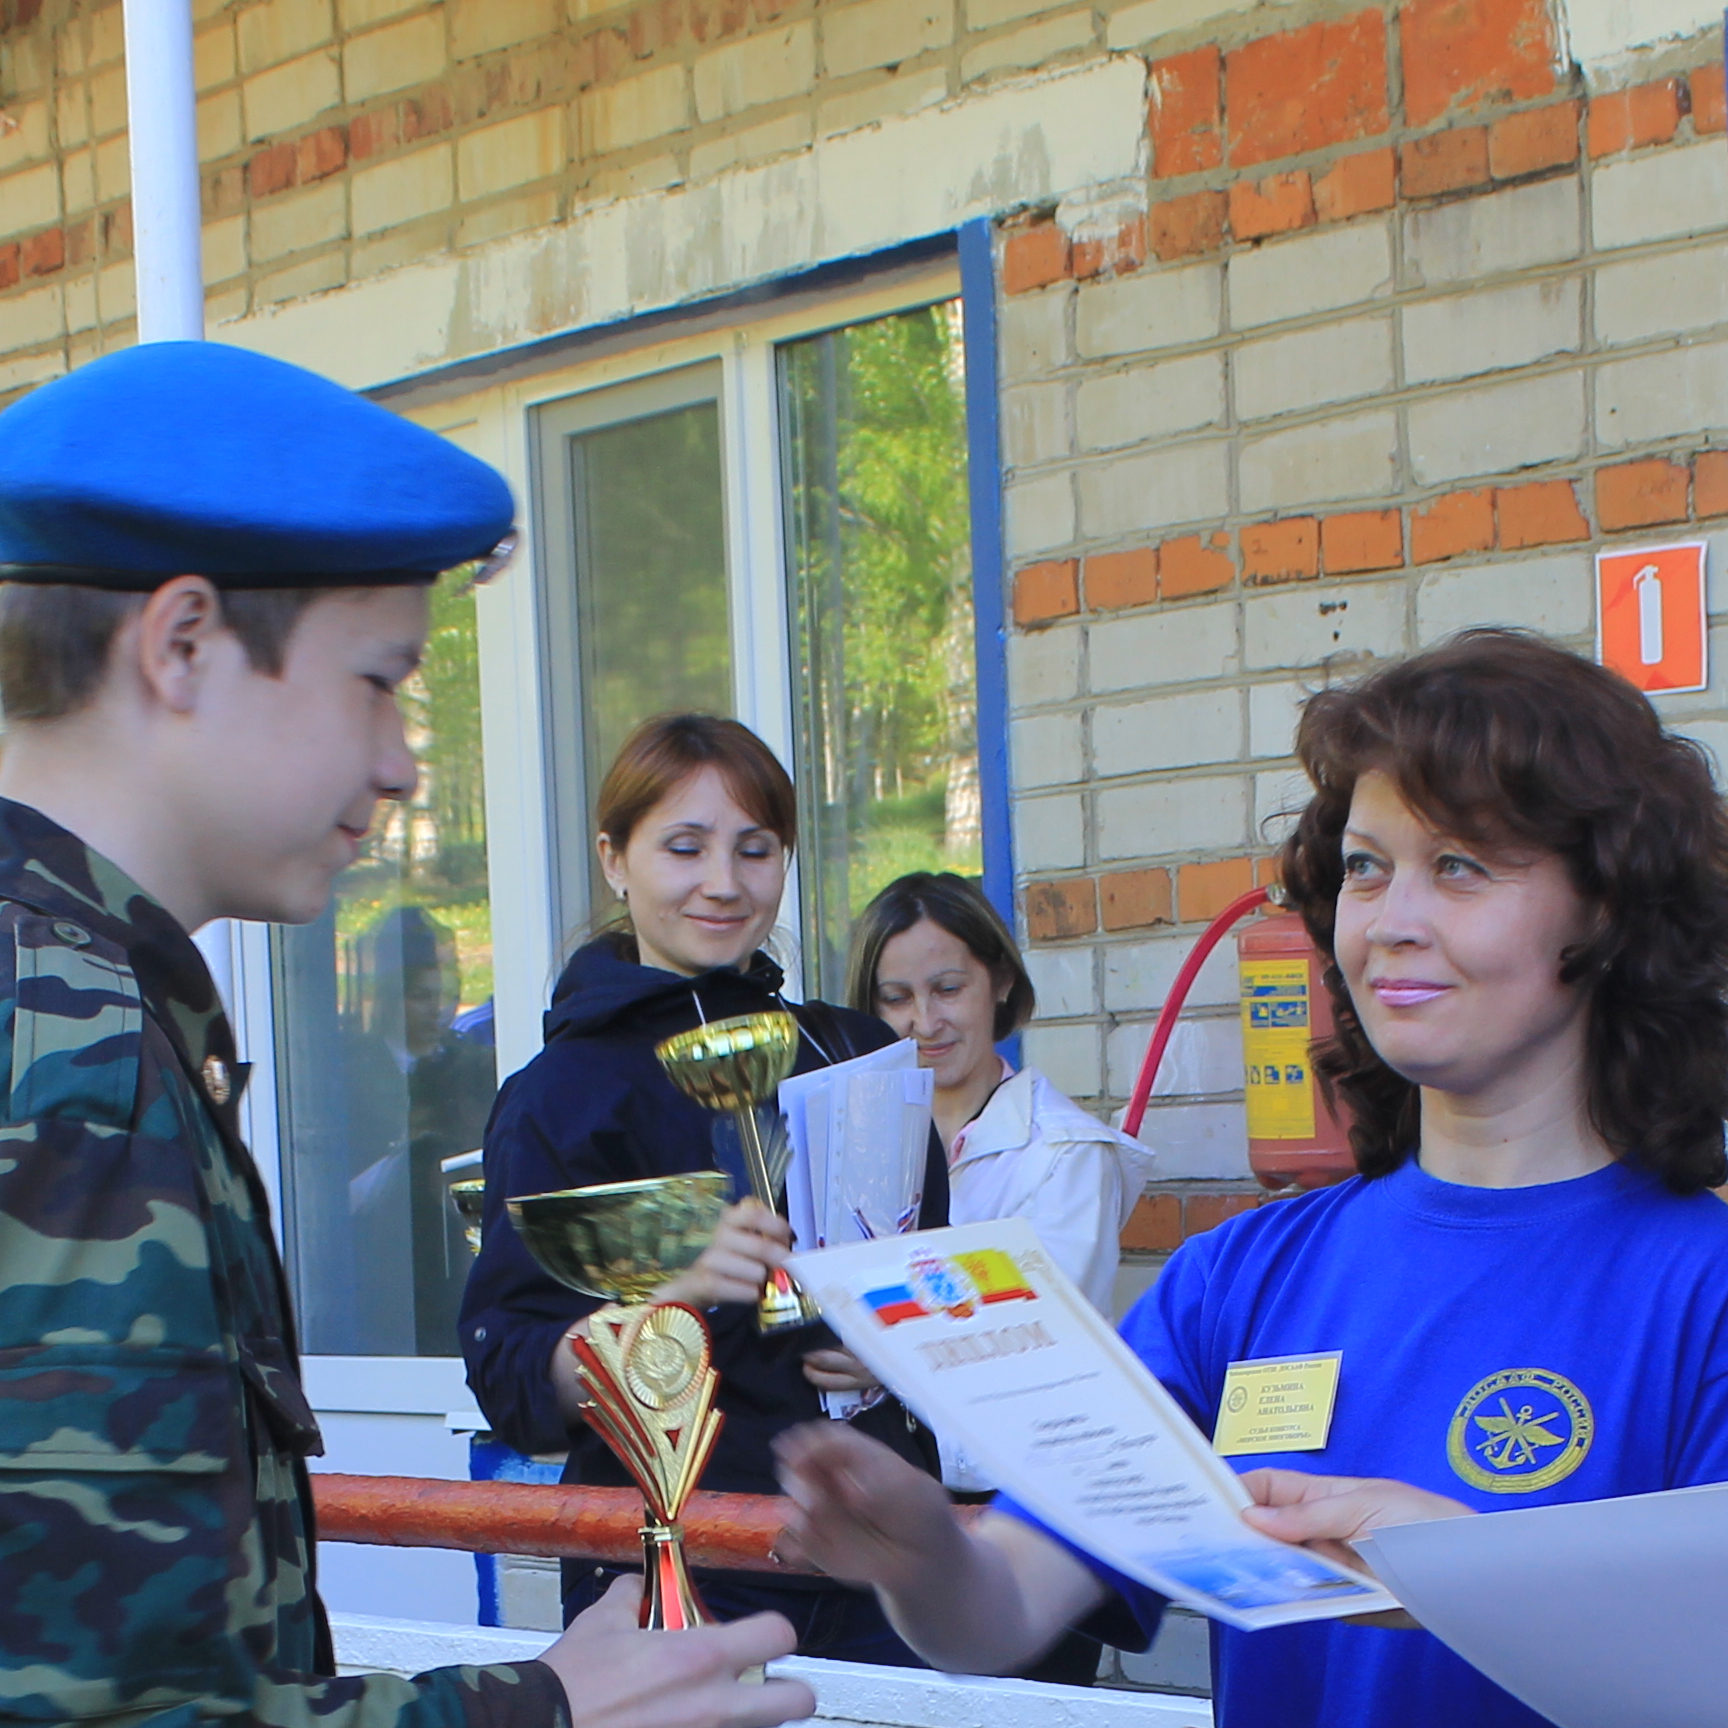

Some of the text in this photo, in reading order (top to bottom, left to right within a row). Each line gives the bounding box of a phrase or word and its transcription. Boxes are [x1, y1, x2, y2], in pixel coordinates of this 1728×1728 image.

[1261, 1382, 1304, 1394] КУЗЬМИНА
[1258, 1395, 1285, 1405] ЕЛЕНА
[1256, 1403, 1314, 1416] АНАТОЛЬЕВНА
